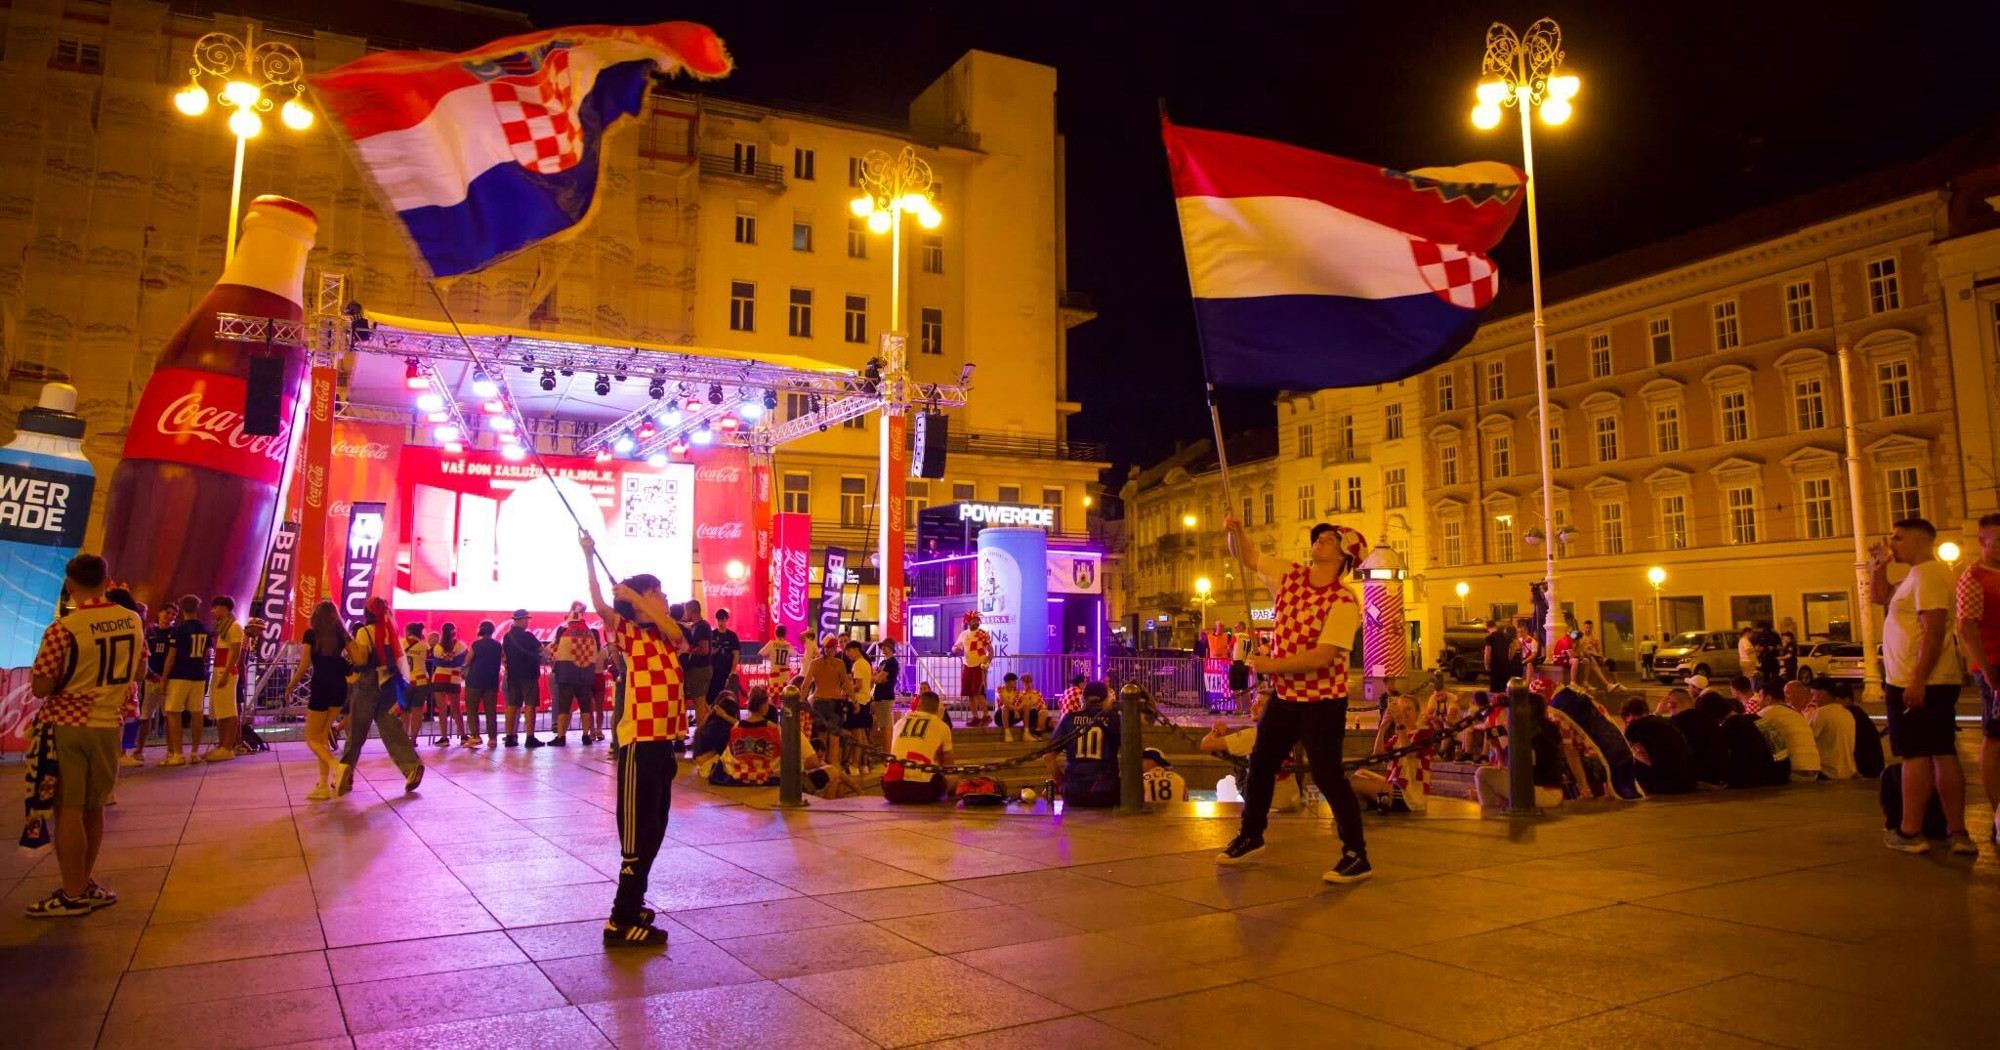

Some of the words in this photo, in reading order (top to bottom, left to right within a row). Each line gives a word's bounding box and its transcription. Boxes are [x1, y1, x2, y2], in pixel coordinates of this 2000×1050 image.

[441, 460, 465, 474] VAŠ
[467, 464, 491, 476] DOM
[494, 464, 556, 479] ZASLUŽUE
[959, 503, 1054, 526] POWERADE
[783, 547, 808, 622] Coca-Cola
[90, 616, 135, 634] MODRIĆ
[1252, 610, 1270, 620] PAR
[189, 633, 207, 658] 10
[775, 648, 789, 665] 10
[95, 634, 135, 687] 10
[900, 717, 931, 738] 10
[1075, 725, 1103, 760] 10
[1148, 779, 1173, 802] 18
